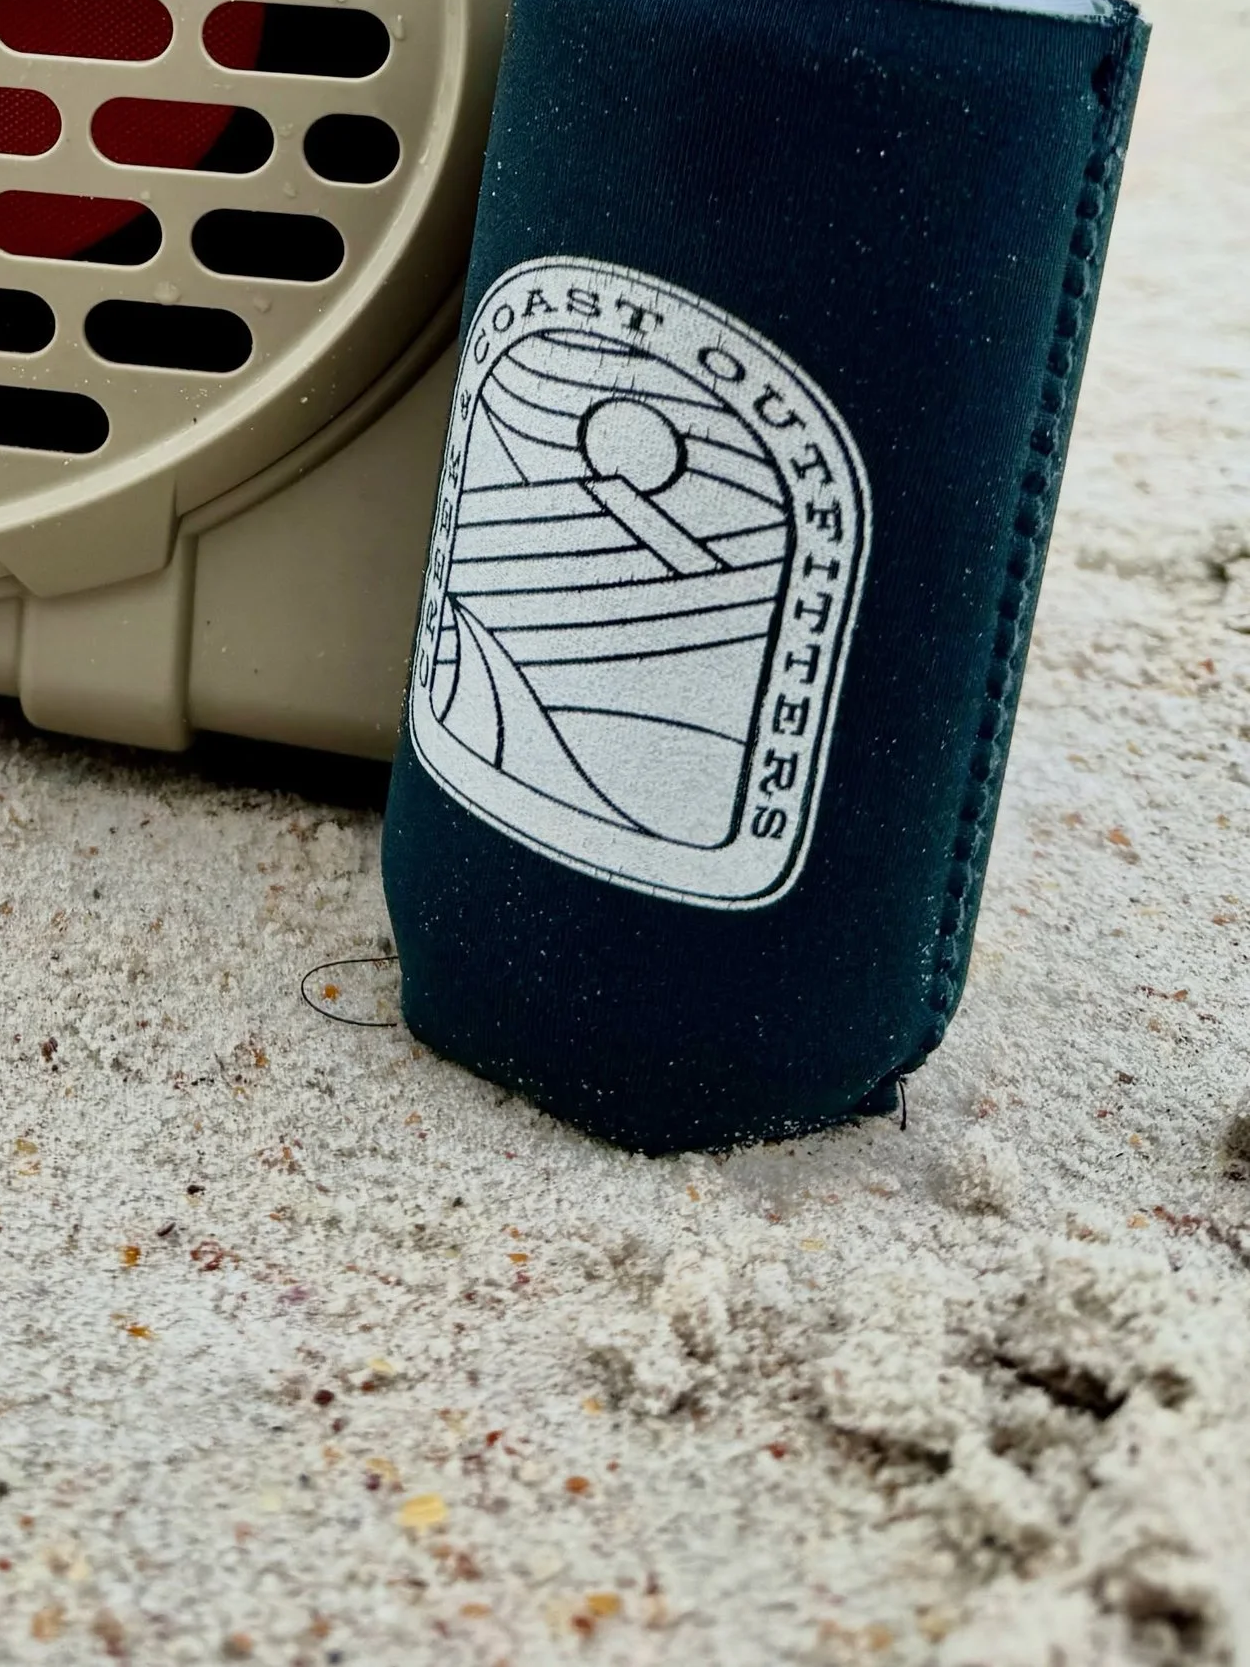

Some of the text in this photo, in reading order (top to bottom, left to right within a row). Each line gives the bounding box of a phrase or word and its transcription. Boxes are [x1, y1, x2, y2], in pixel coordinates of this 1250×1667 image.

[419, 444, 462, 688] CREEK
[473, 287, 665, 365] COAST
[697, 346, 844, 840] OUTFITTERS
